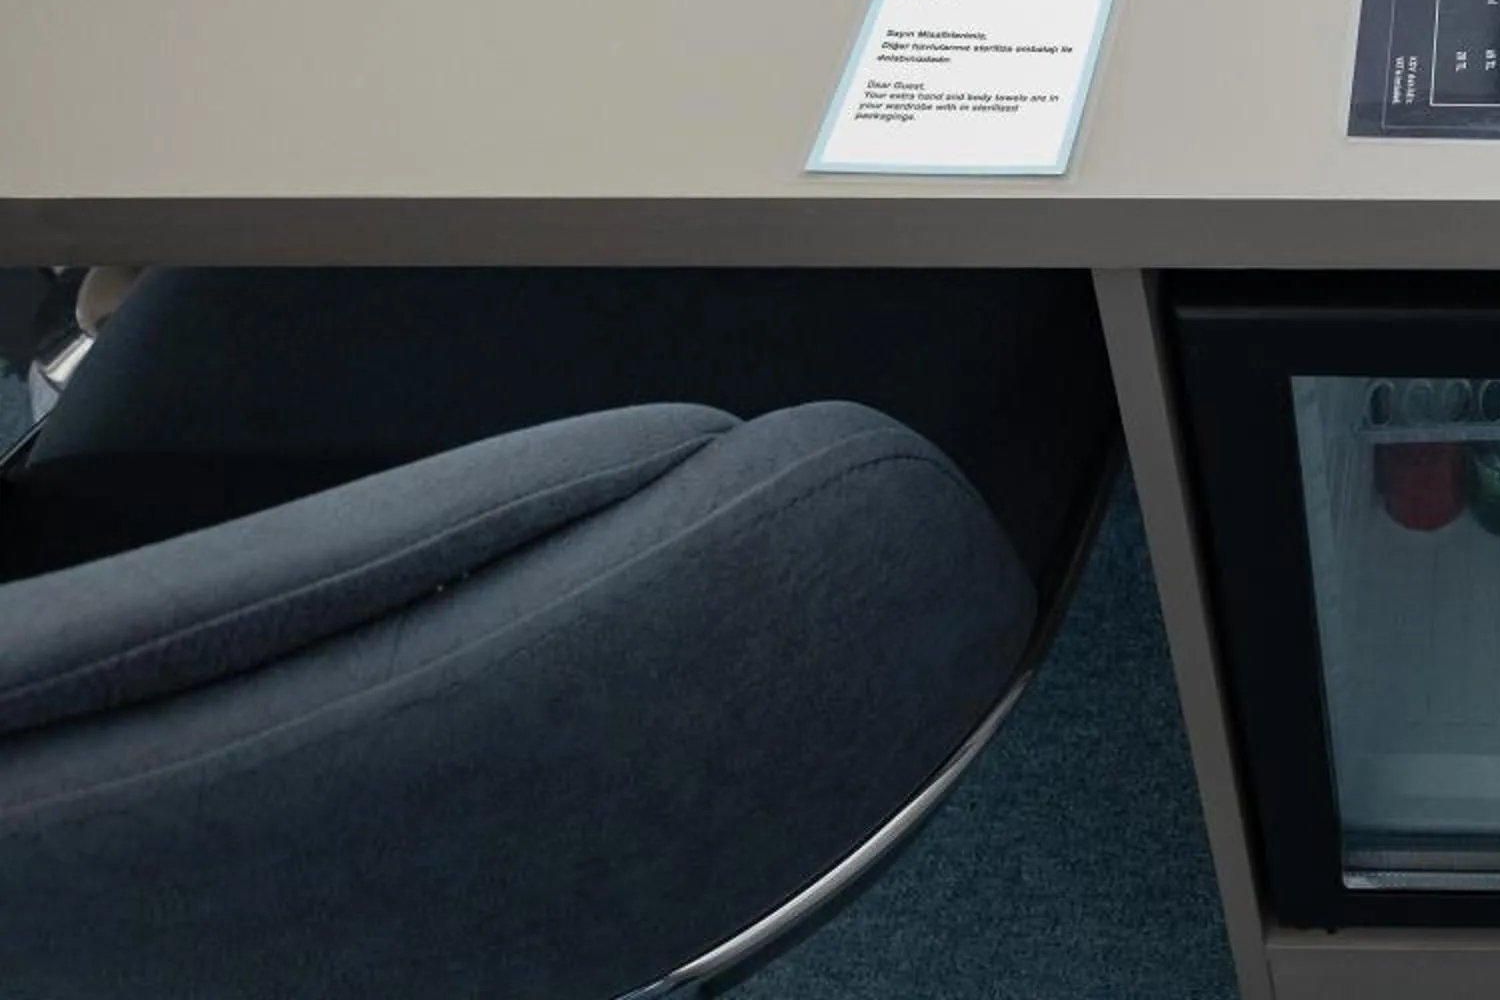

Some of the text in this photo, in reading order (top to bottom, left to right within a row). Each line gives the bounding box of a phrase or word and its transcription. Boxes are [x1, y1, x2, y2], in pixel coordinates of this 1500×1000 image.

[865, 80, 893, 89] Dear
[916, 92, 945, 100] hand
[965, 94, 992, 102] body
[857, 102, 883, 110] your
[884, 102, 933, 110] wardrobe
